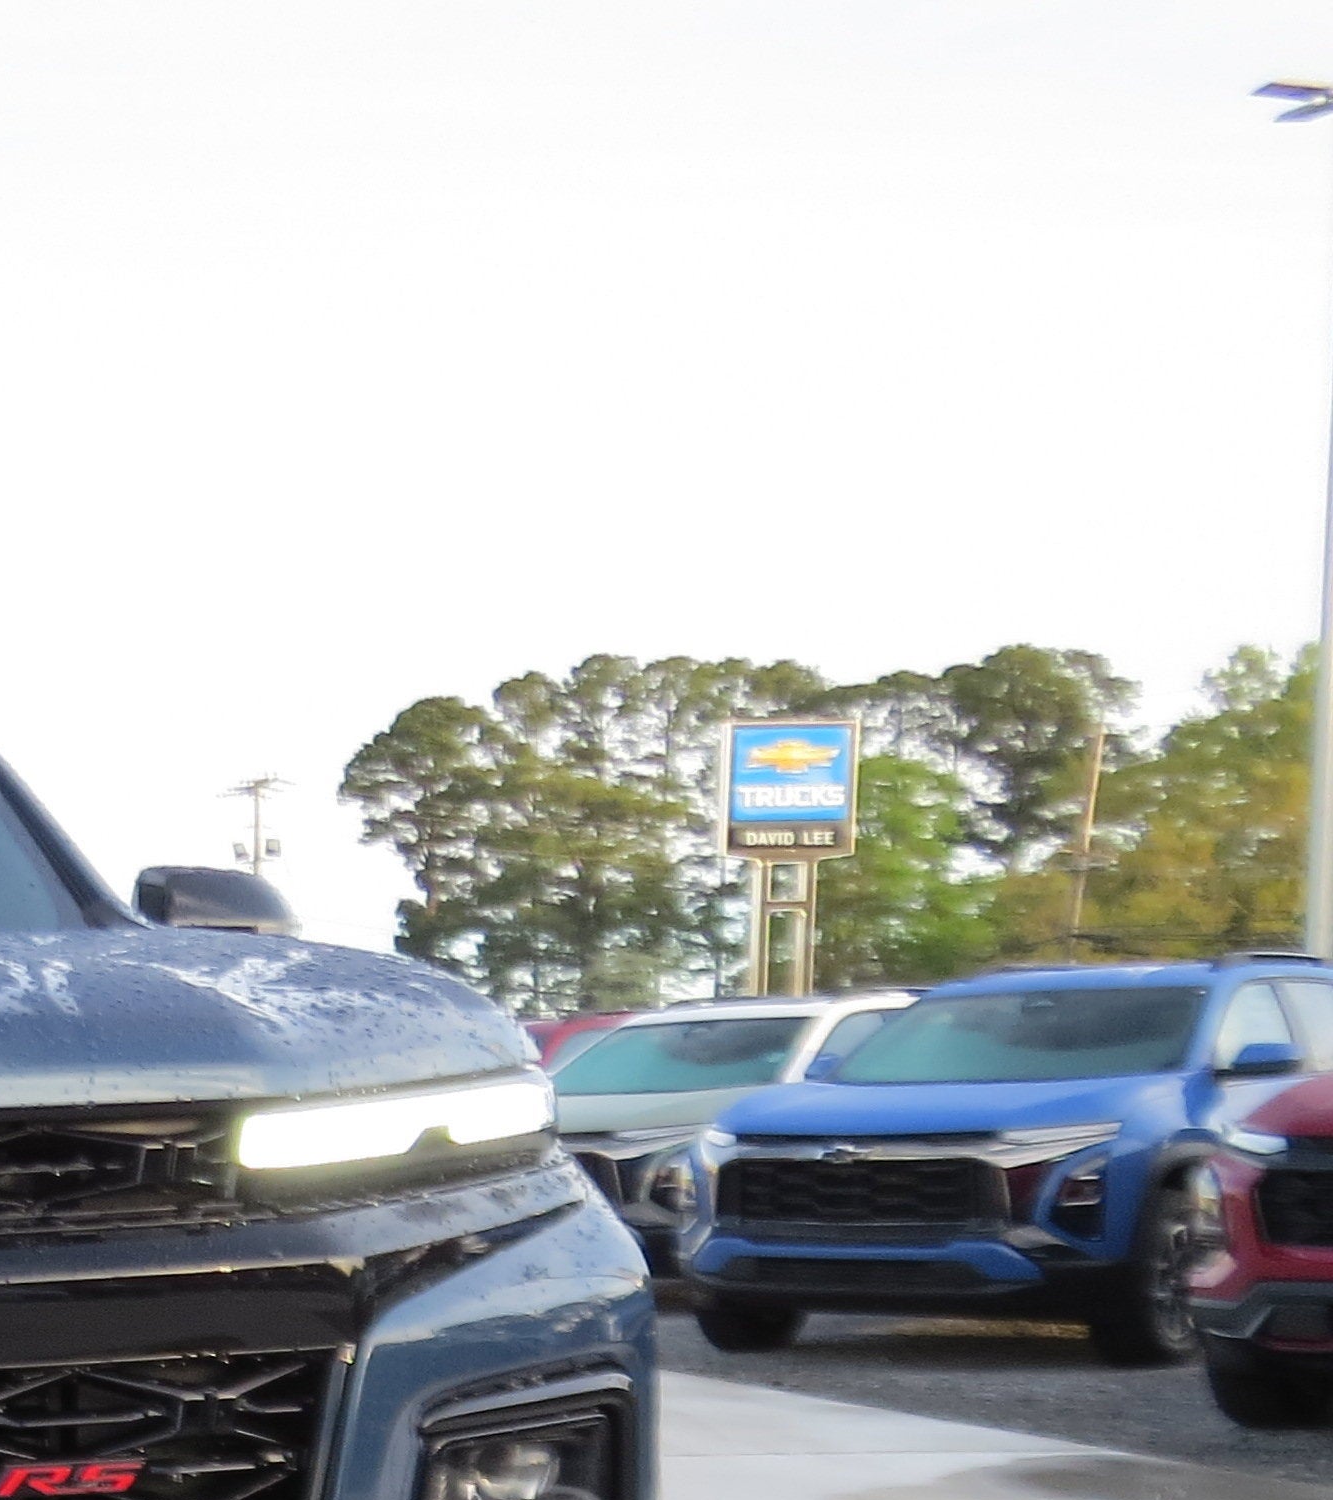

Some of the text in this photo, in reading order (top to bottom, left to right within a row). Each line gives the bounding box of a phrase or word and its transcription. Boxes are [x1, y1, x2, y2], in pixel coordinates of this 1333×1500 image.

[739, 785, 845, 807] TRUCKS
[746, 831, 835, 846] DAVID LEE
